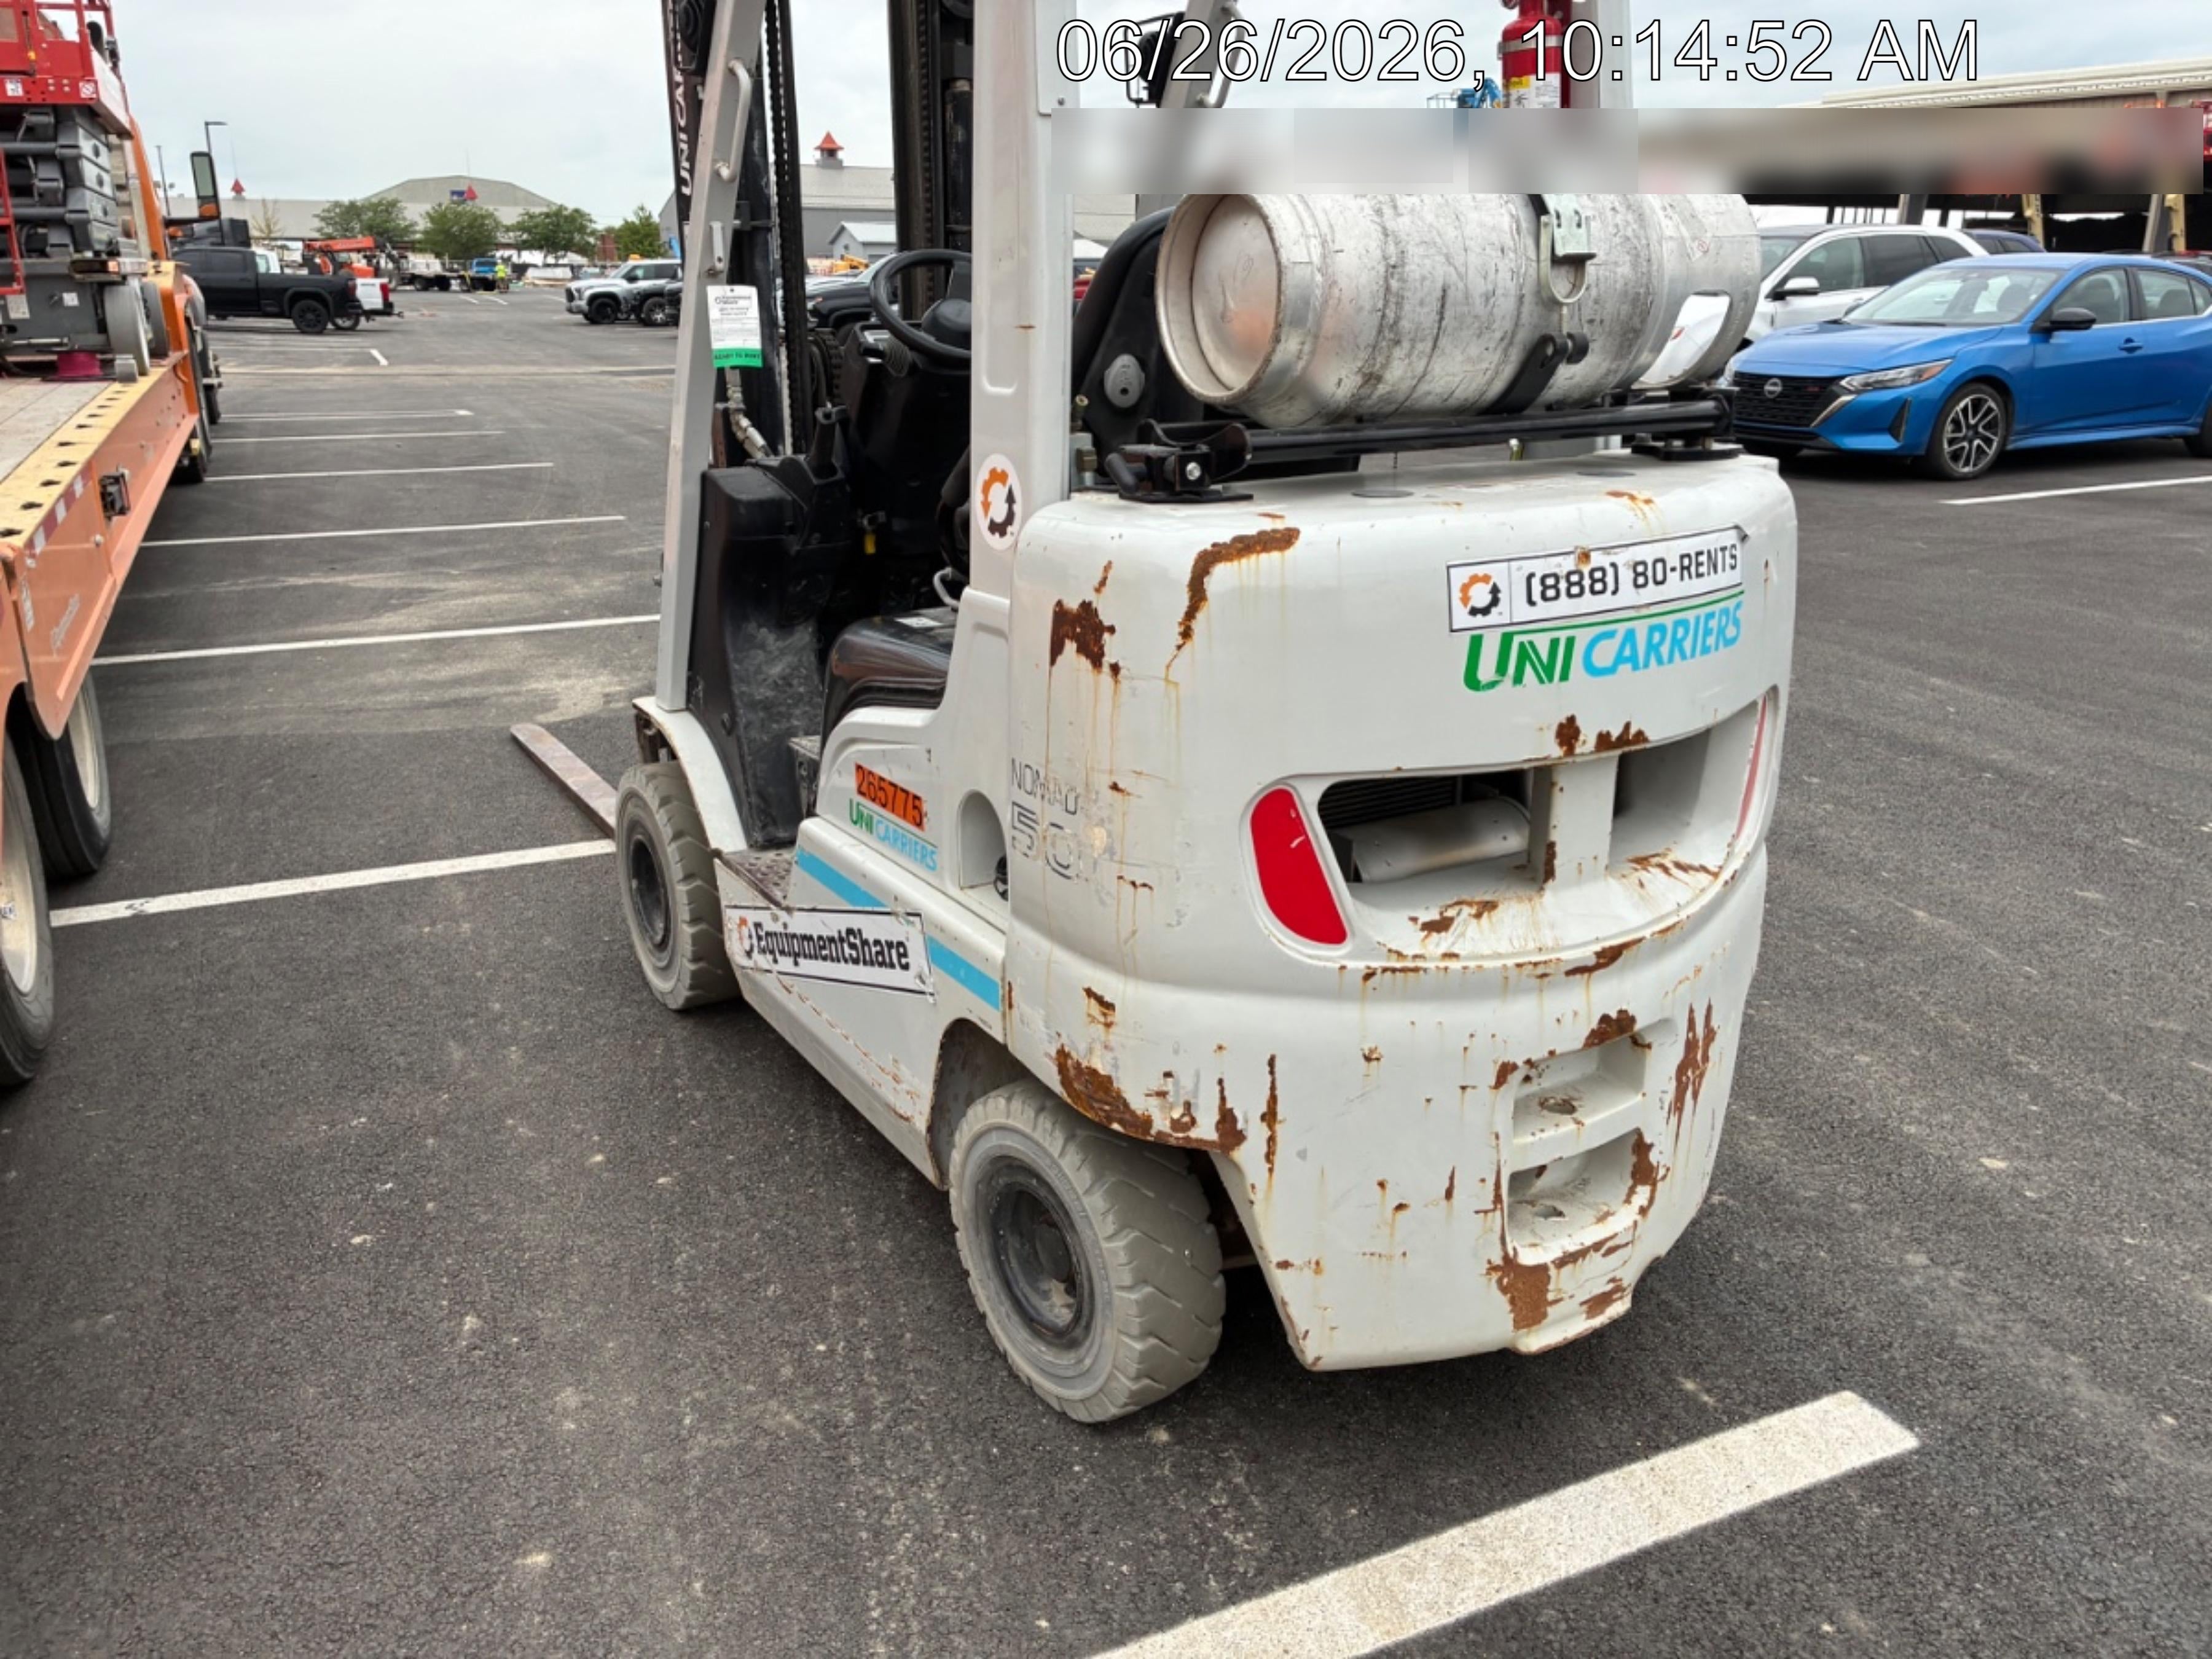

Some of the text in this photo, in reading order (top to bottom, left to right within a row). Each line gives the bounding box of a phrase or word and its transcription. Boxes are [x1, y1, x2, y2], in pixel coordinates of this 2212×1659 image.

[1526, 543, 1738, 607] (888) 80-RENTS
[855, 763, 923, 828] 265775
[753, 921, 910, 971] EquipmentShare
